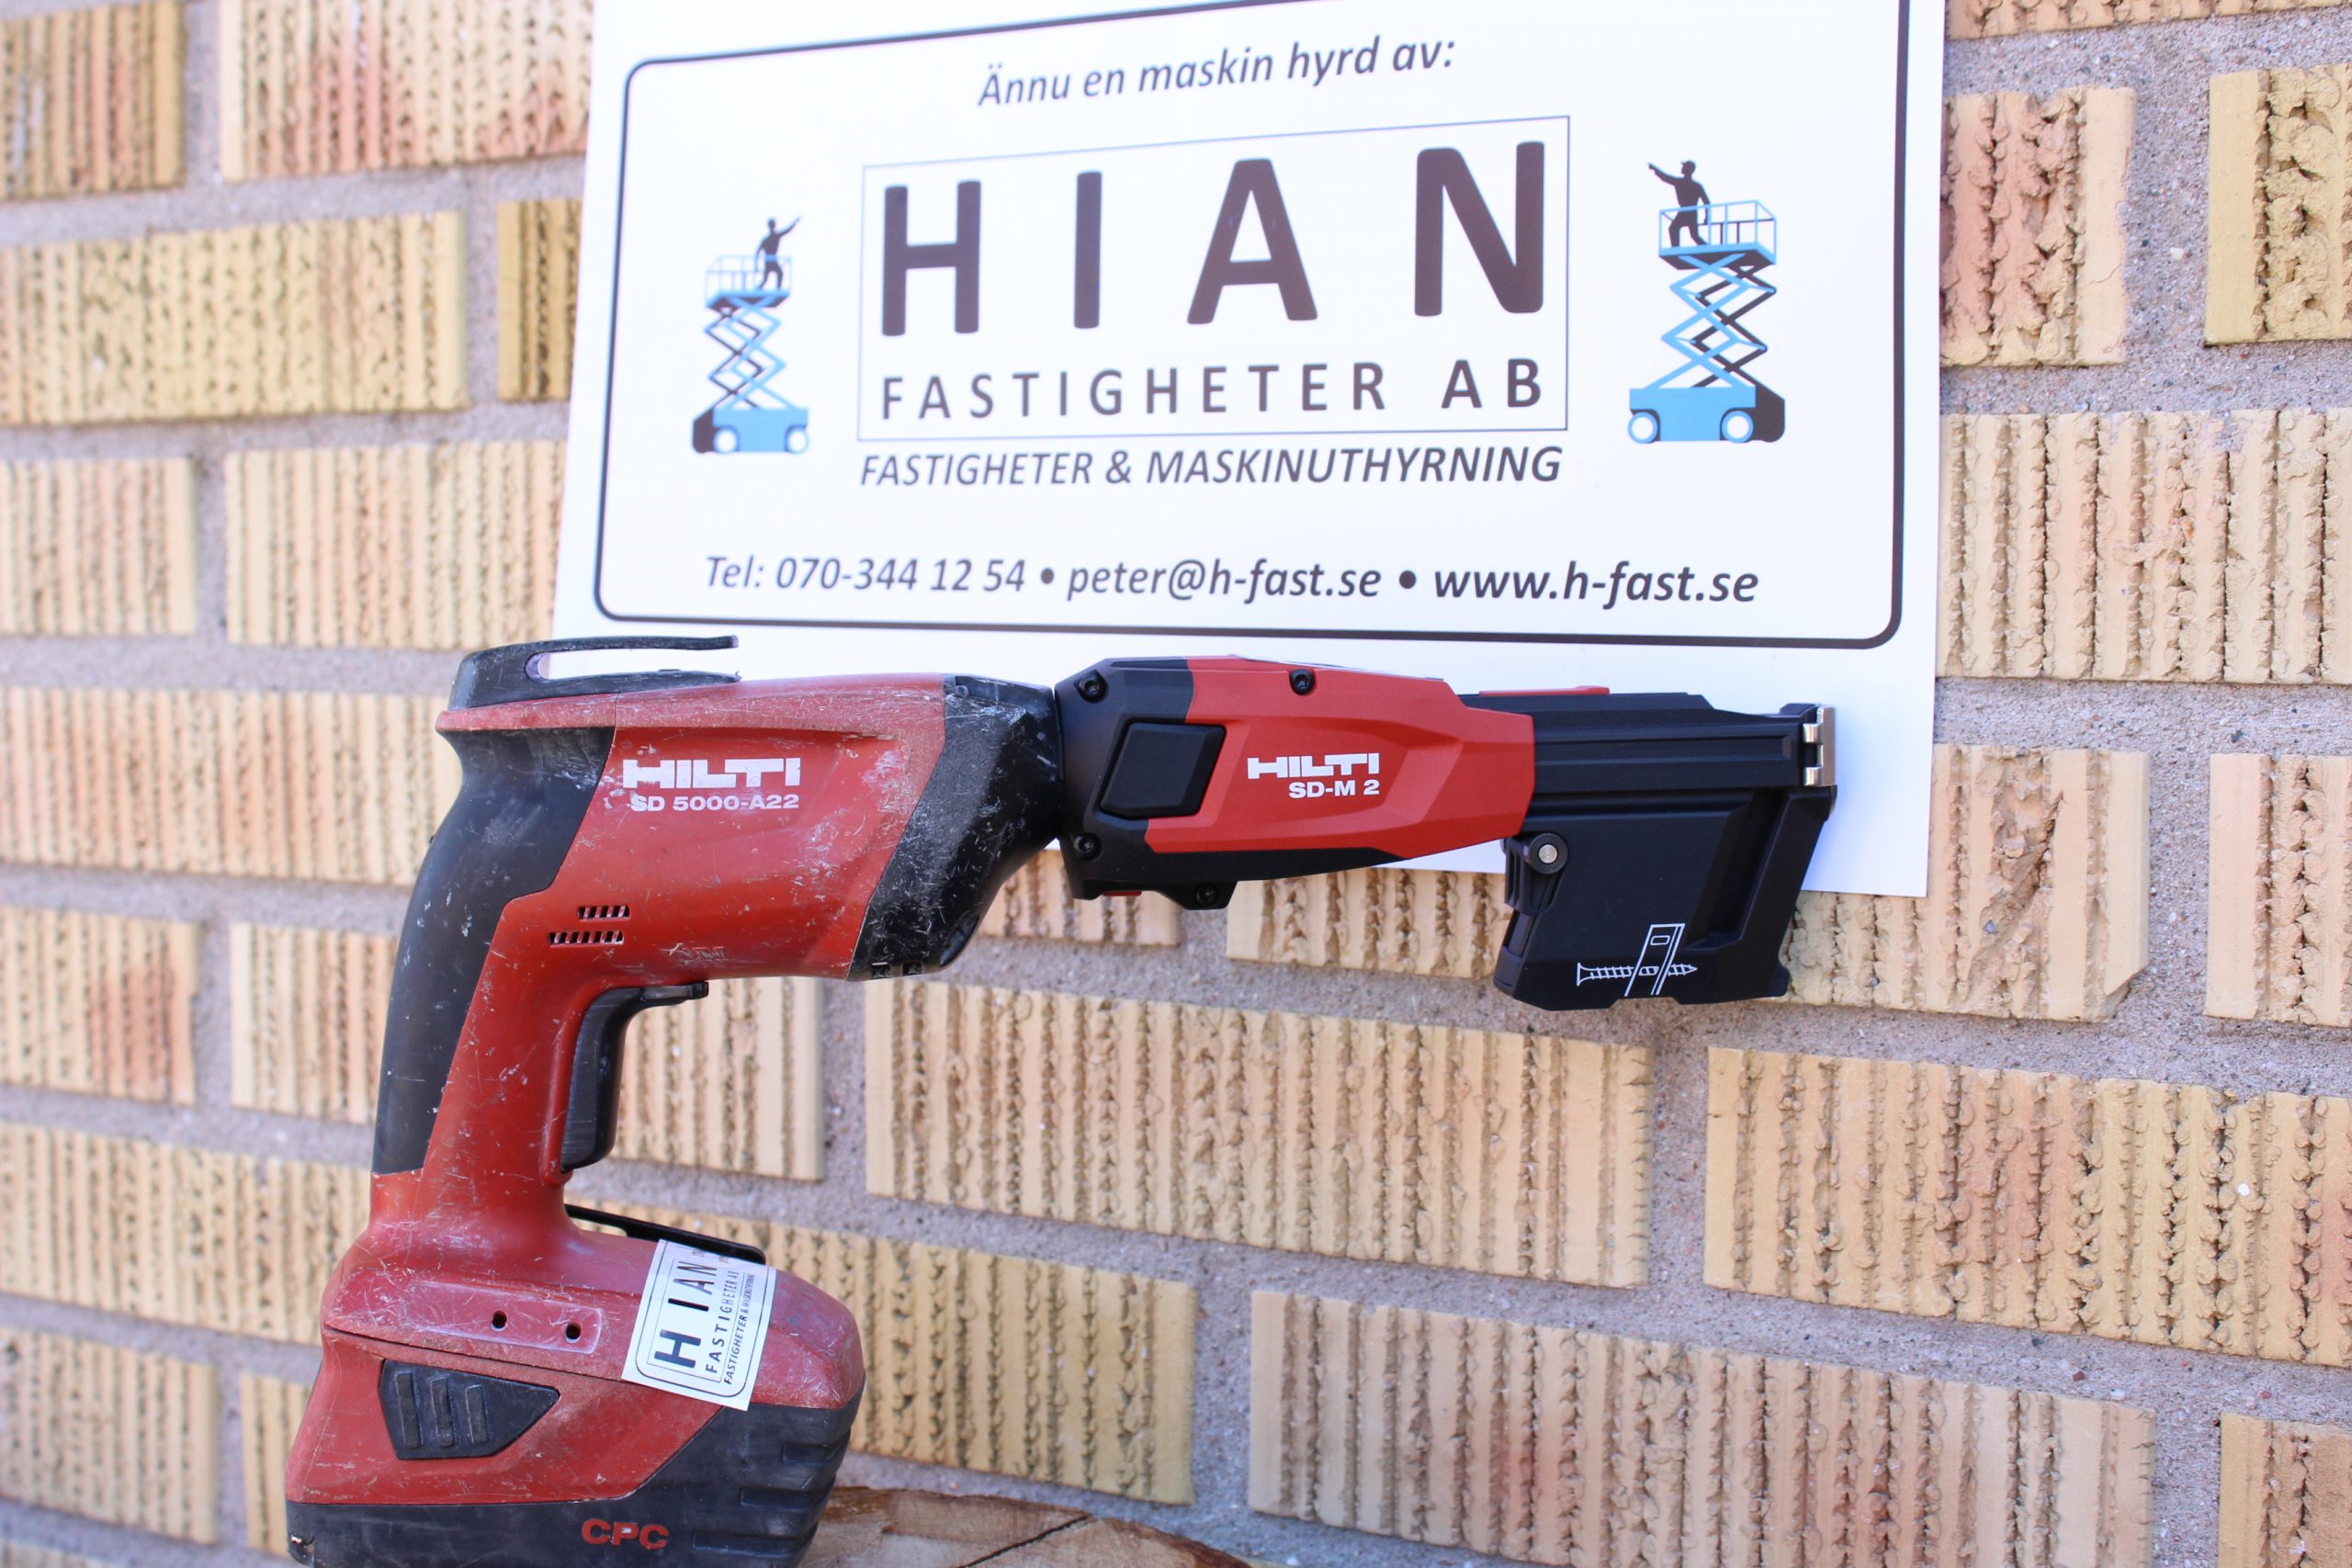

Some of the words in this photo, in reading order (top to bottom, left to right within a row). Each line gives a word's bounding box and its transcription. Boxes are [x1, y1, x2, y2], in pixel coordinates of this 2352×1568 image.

[978, 63, 1070, 107] Ännu
[1083, 69, 1125, 97] en
[1138, 47, 1273, 93] maskin
[1287, 34, 1381, 87] hyrd
[1392, 40, 1456, 72] av:
[881, 141, 1545, 337] HIAN
[882, 362, 1385, 421] FASTIGHETER
[1441, 357, 1542, 410] AB
[861, 451, 1093, 486] FASTIGHETER
[1104, 449, 1133, 485] &
[1146, 445, 1564, 484] MASKINUTHYRNING
[706, 555, 764, 588] Tel:
[775, 557, 918, 591] 070-344
[930, 558, 973, 592] 12
[982, 558, 1025, 592] 54
[1067, 557, 1382, 605] peter@h-fast.se
[1433, 559, 1759, 611] www.h-fast.se
[622, 758, 801, 788] HILTI
[1247, 752, 1380, 779] HILTI
[1288, 780, 1356, 798] SD-M
[1363, 779, 1380, 795] 2
[630, 795, 666, 811] SD
[673, 794, 799, 811] 5000-A22
[654, 1260, 718, 1369] HIAN
[724, 1314, 747, 1385] FASTIGHETER
[581, 1517, 670, 1551] CPC
